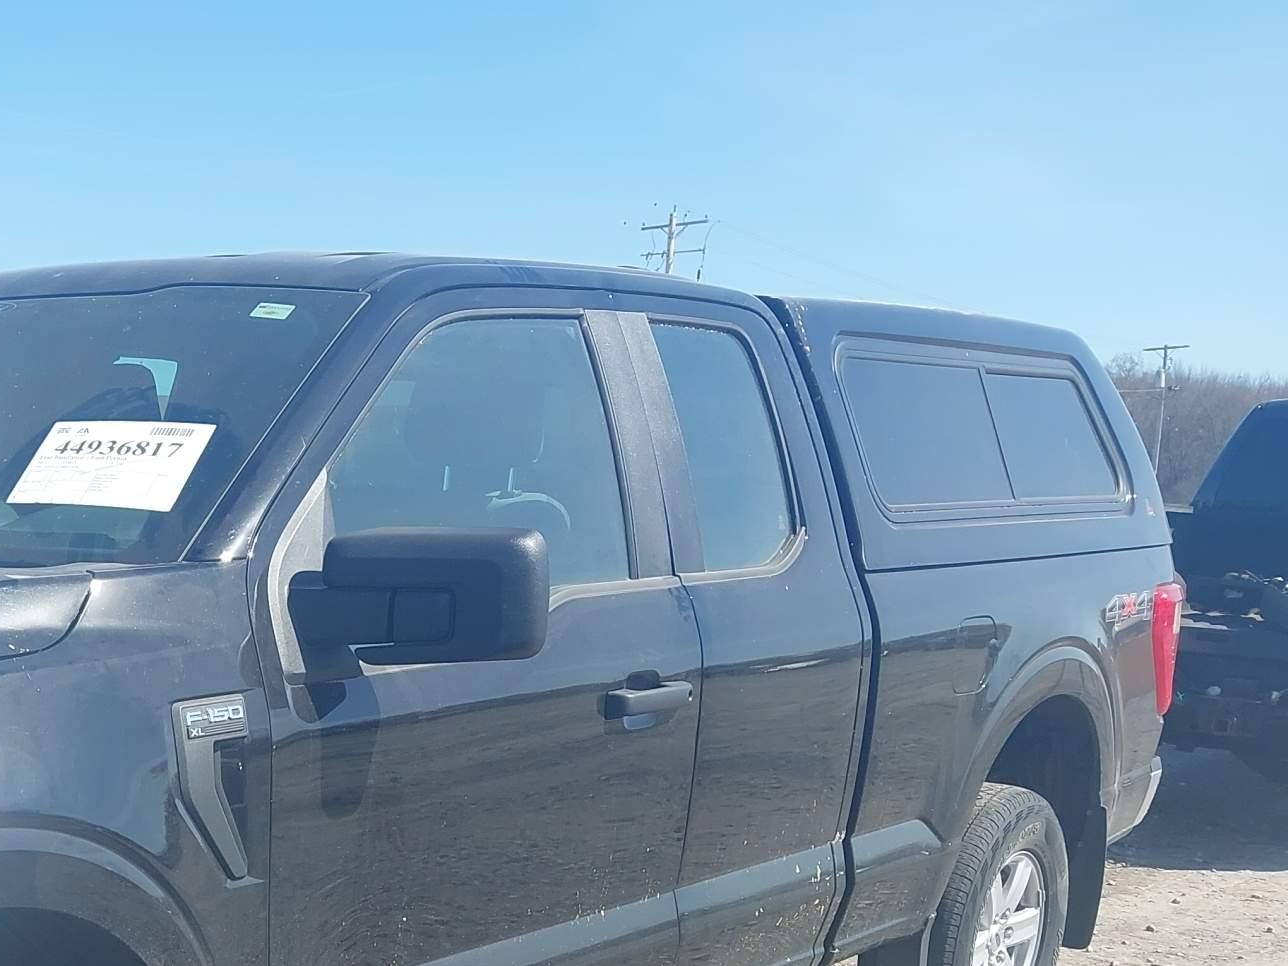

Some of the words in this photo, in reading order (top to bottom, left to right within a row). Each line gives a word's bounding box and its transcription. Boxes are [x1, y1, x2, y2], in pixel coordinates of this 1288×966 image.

[54, 440, 185, 458] 44936817
[186, 705, 244, 726] F-150
[190, 728, 205, 737] XL
